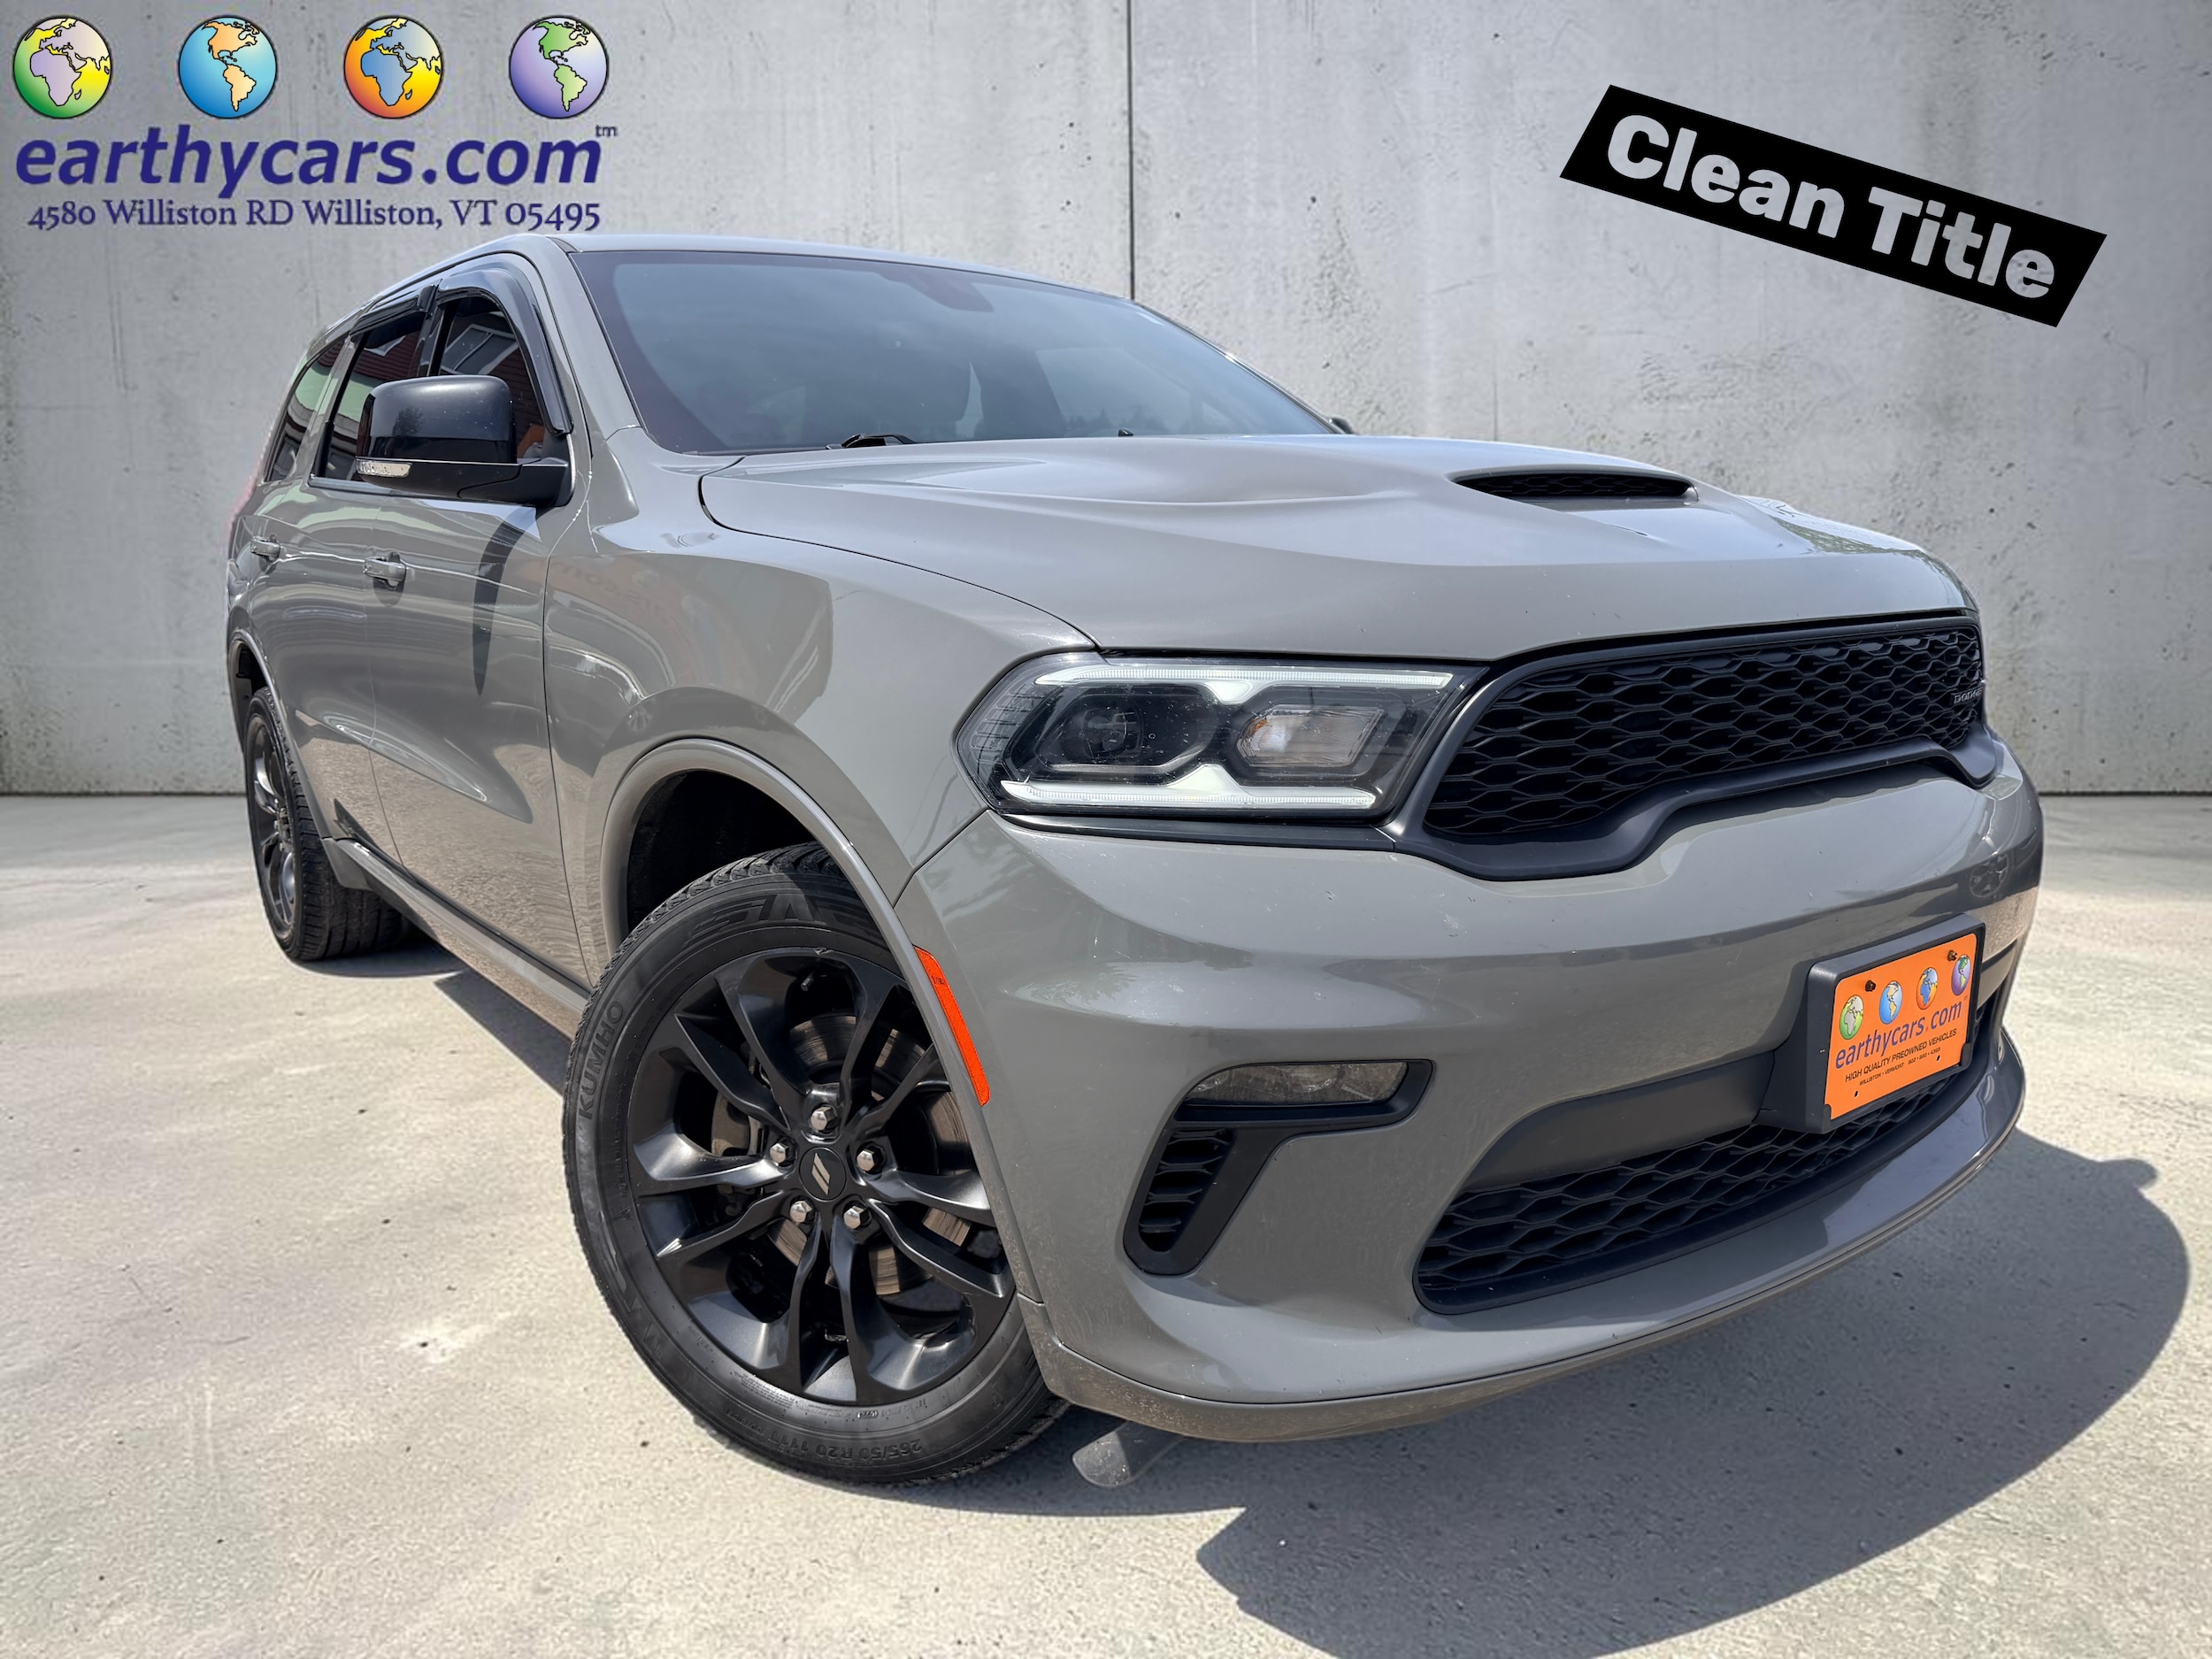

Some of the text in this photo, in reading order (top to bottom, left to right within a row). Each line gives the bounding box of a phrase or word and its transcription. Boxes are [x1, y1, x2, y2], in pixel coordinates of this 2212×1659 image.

[578, 1000, 624, 1120] KUMHO
[1835, 1001, 1962, 1069] earthycars.com
[1845, 1028, 1957, 1083] HIGH QUALITY PREOWNED VEHICLES
[1859, 1072, 1882, 1087] WILLISTON
[1884, 1063, 1905, 1076] VERMONT
[767, 1431, 922, 1460] 265/50 R20 111T
